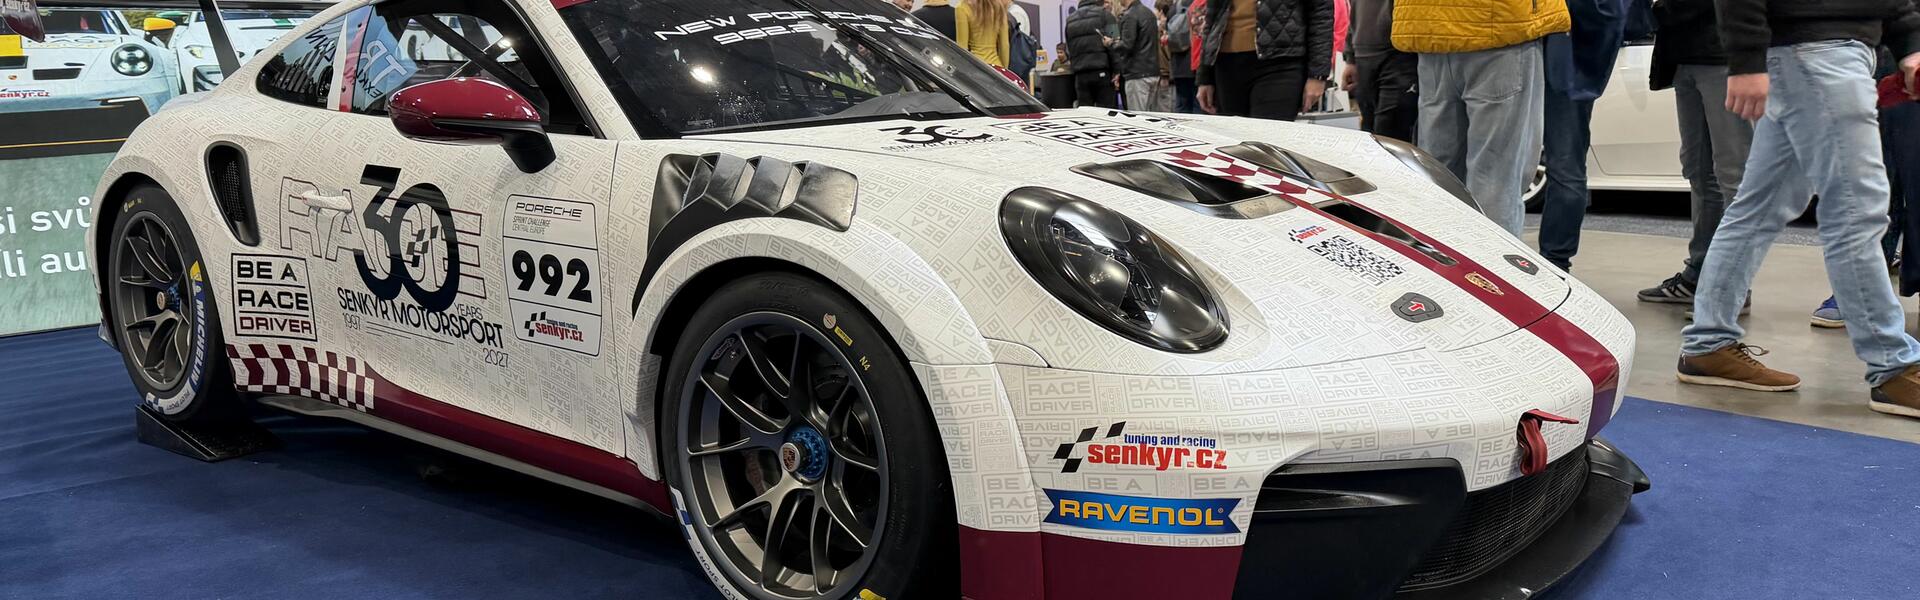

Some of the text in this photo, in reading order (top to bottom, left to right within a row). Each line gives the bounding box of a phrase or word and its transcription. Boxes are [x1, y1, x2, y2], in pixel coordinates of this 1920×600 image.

[654, 16, 736, 41] NEW
[713, 24, 819, 45] 992.2
[1020, 119, 1095, 132] BE A
[1050, 127, 1156, 143] RACE
[1093, 136, 1195, 153] DRIVER
[516, 202, 583, 218] PORSCHE
[926, 192, 970, 217] DRIVER
[914, 201, 961, 229] RACE
[359, 163, 460, 312] 30
[922, 223, 948, 246] BE
[237, 260, 298, 282] BE A
[512, 249, 593, 304] 992
[238, 289, 310, 311] RACE
[337, 287, 503, 349] SENKYR MOTORSPORT
[454, 303, 484, 321] YEARS
[239, 316, 312, 335] DRIVER
[342, 312, 361, 331] 1997
[535, 322, 584, 342] senkyr.cz
[191, 299, 205, 386] MICHELIN
[483, 348, 510, 369] 2027
[859, 355, 871, 371] N4
[1398, 362, 1447, 378] RACE
[1128, 377, 1192, 392] RACE
[1227, 377, 1287, 391] RACE
[1317, 371, 1373, 386] RACE
[1406, 377, 1457, 392] DRIVER
[931, 383, 993, 400] RACE
[1028, 381, 1091, 396] RACE
[1324, 384, 1382, 399] DRIVER
[1030, 400, 1094, 412] DRIVER
[1131, 397, 1197, 410] DRIVER
[1232, 393, 1294, 408] DRIVER
[935, 403, 995, 417] DRIVER
[1124, 433, 1216, 448] tuning and racing
[1481, 439, 1503, 454] BE
[1087, 443, 1227, 471] senkyr.cz
[987, 477, 1020, 491] BE
[1088, 477, 1142, 491] BE A
[1195, 477, 1250, 490] BE A
[1059, 498, 1224, 527] RAVENOL
